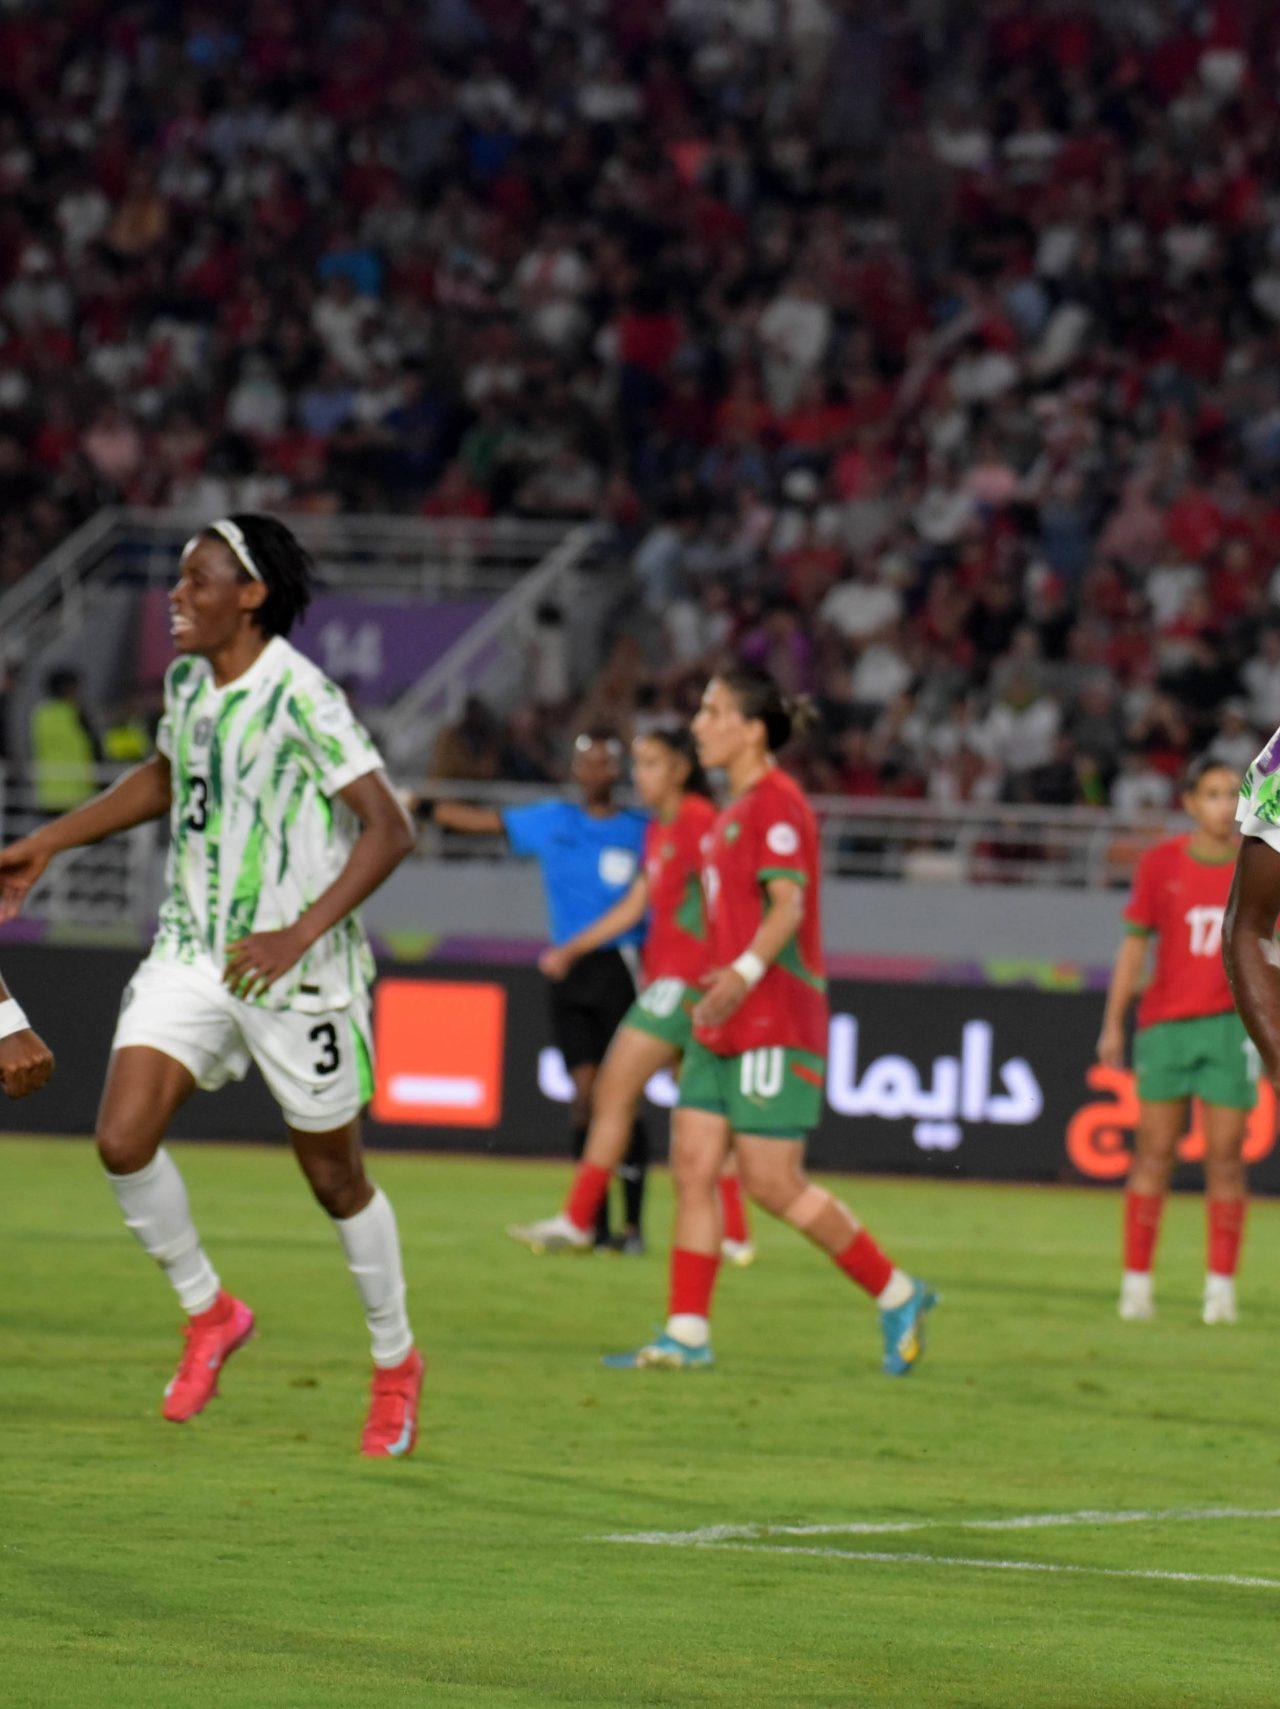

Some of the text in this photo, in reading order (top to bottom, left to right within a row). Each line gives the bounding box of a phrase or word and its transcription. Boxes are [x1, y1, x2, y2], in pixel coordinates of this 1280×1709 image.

[321, 620, 382, 679] 14
[188, 776, 207, 831] 3
[1184, 906, 1225, 957] 17
[309, 1021, 339, 1076] 3
[740, 1046, 784, 1098] 10
[826, 1014, 1043, 1151] دايما
